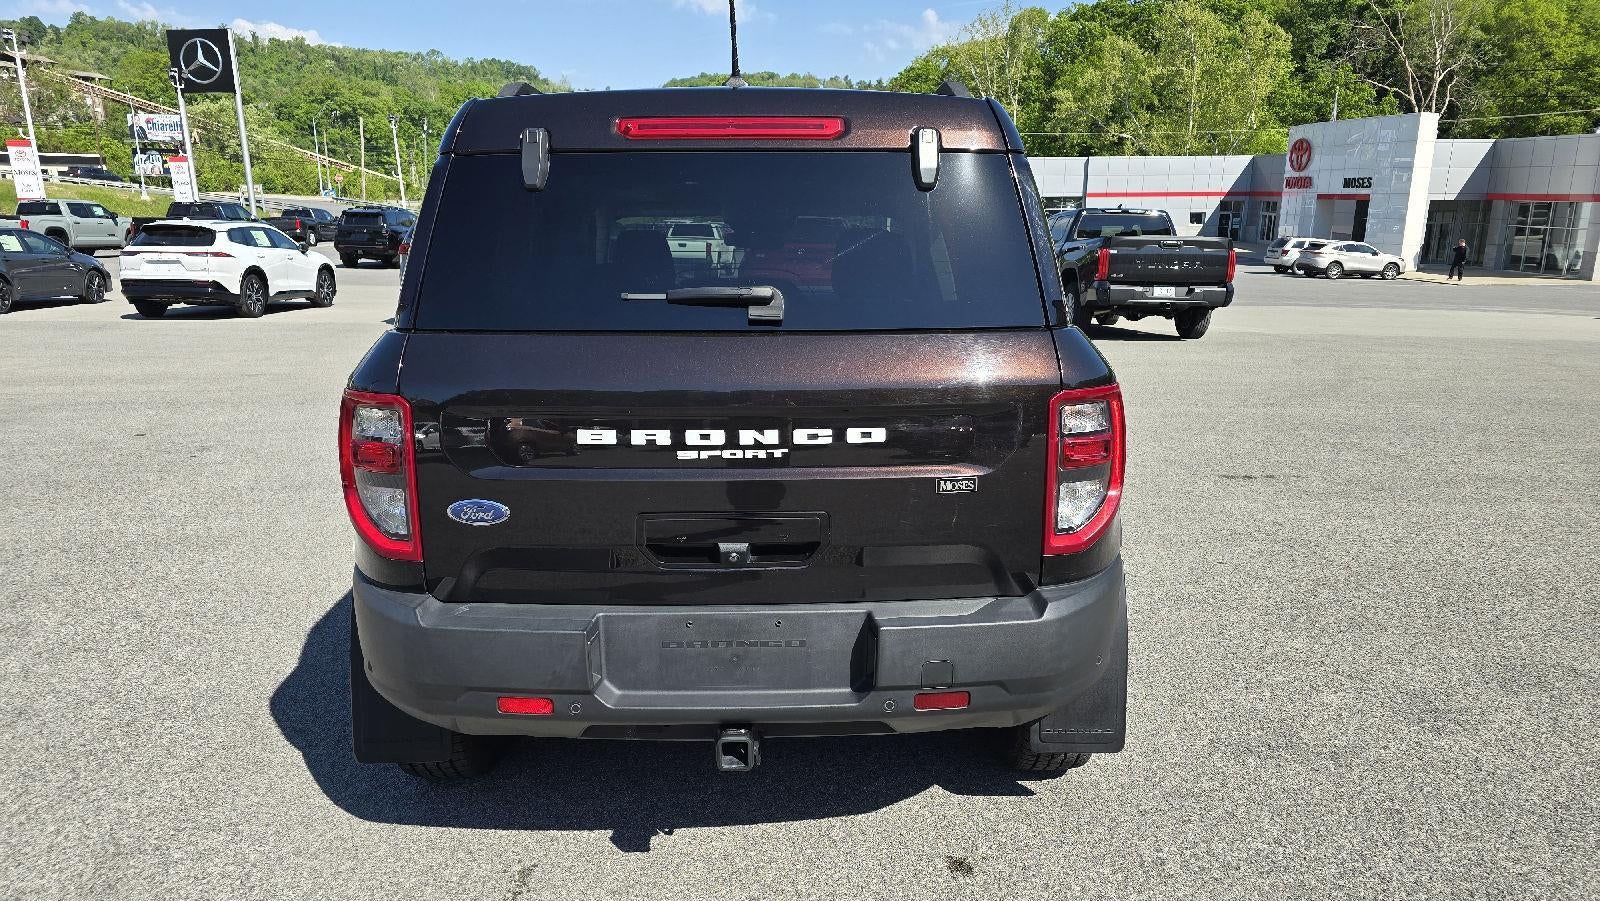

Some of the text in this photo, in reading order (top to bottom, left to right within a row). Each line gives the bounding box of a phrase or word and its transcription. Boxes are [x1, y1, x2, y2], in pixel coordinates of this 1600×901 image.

[146, 120, 183, 132] Chiarelli
[1285, 176, 1312, 189] TOYOTA
[1343, 177, 1373, 189] MOSES
[576, 427, 888, 446] BRONCO
[676, 448, 789, 460] SPORT
[939, 480, 975, 491] MOSES
[460, 505, 495, 520] Ford
[661, 638, 807, 649] BRONCO
